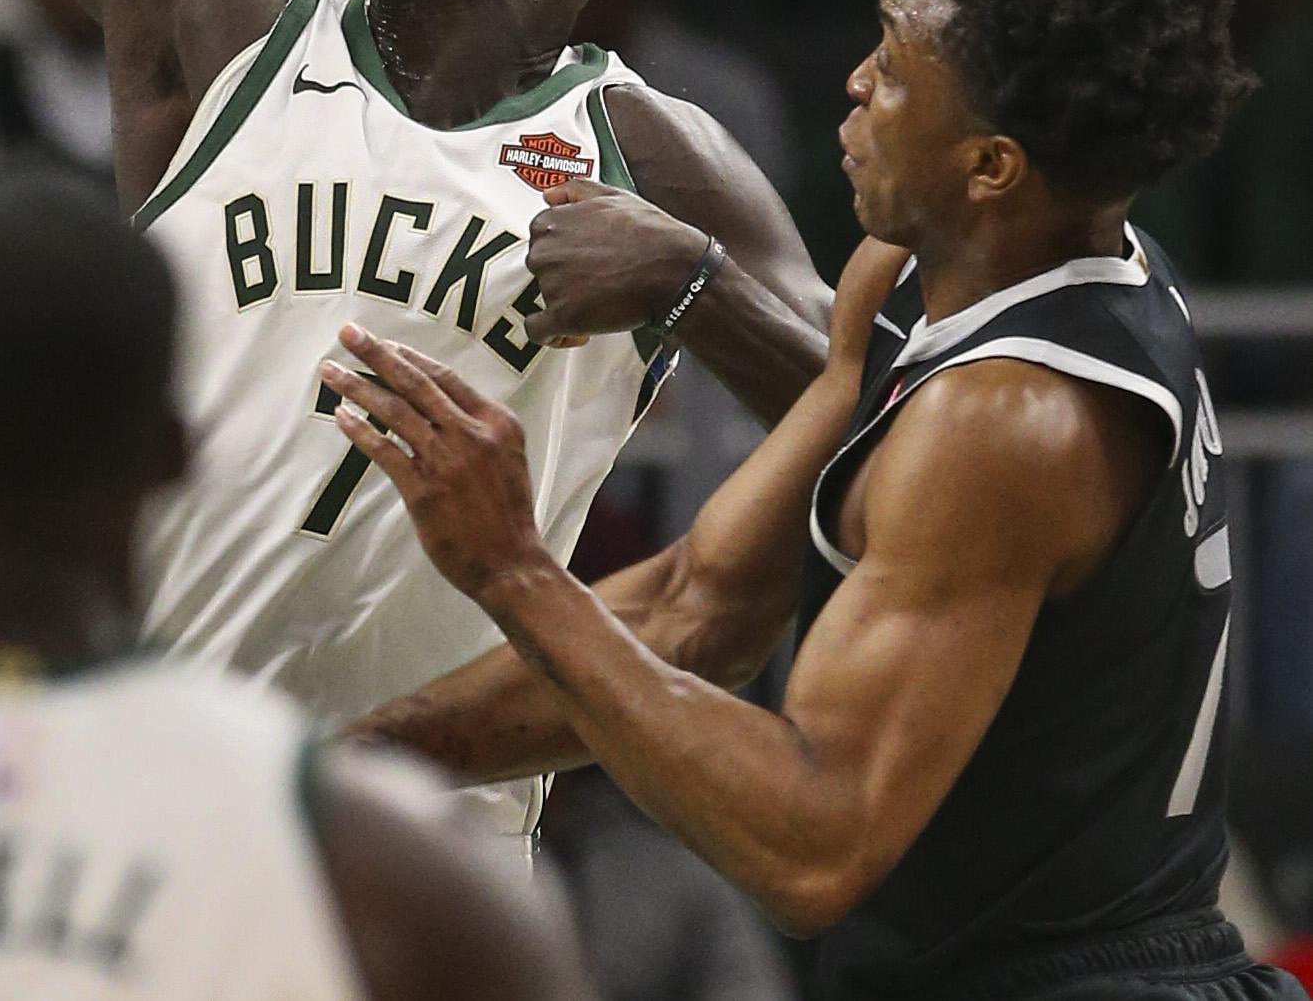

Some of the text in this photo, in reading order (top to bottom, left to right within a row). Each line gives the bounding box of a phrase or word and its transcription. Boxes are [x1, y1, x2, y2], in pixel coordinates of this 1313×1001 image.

[526, 137, 571, 156] MOTOR
[505, 148, 588, 175] HARLEY-DAVIDSON
[522, 169, 566, 188] CYCLES
[223, 180, 547, 376] BUCKS
[298, 366, 398, 540] 7
